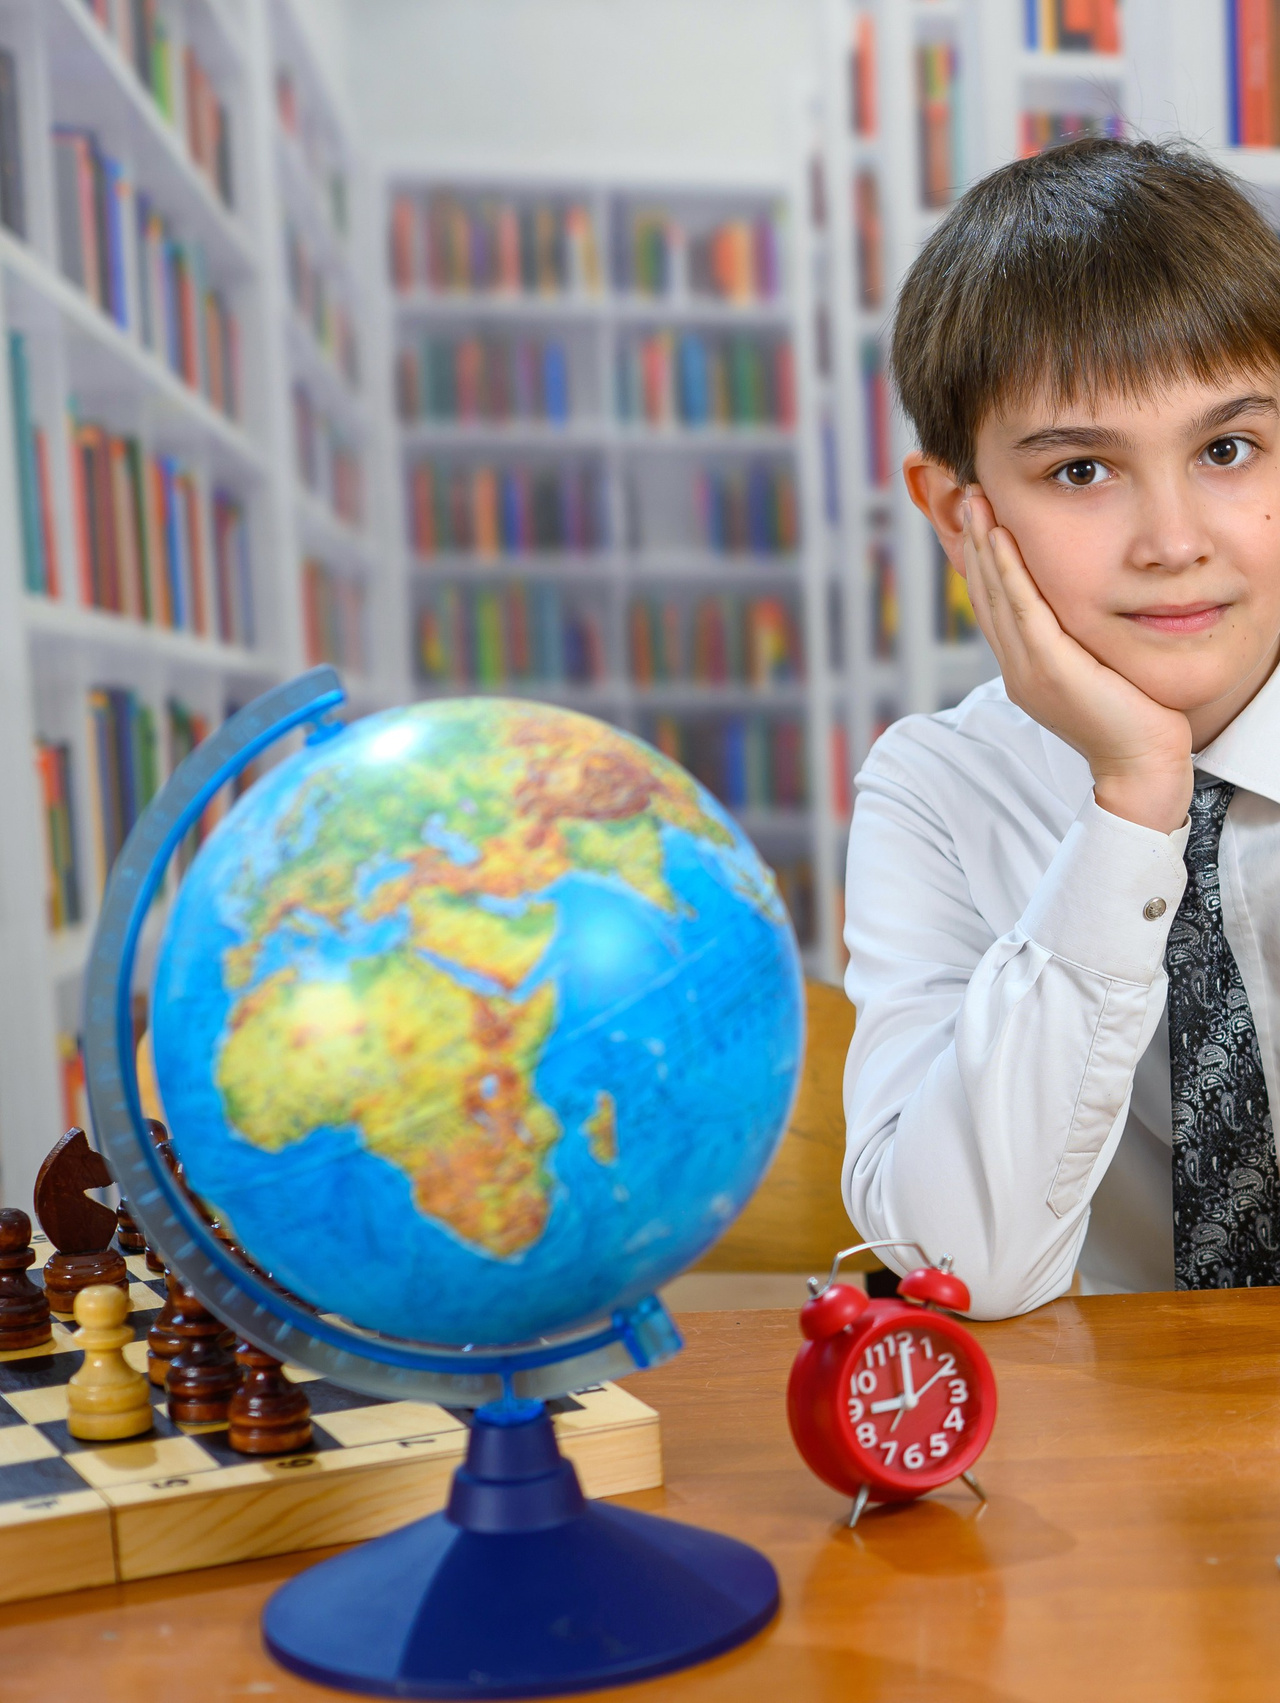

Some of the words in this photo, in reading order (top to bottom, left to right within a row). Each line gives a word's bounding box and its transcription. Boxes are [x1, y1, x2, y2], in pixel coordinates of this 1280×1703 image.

[865, 1343, 885, 1368] 11
[884, 1332, 915, 1356] 12
[921, 1336, 933, 1359] 1
[938, 1353, 957, 1376] 2
[851, 1370, 877, 1395] 10
[948, 1379, 968, 1403] 3
[848, 1398, 864, 1423] 9
[943, 1407, 965, 1431] 4
[856, 1422, 877, 1448] 8
[930, 1432, 949, 1457] 5
[277, 1458, 314, 1469] 6
[880, 1441, 898, 1466] 7
[903, 1443, 925, 1469] 6
[150, 1479, 189, 1490] 5
